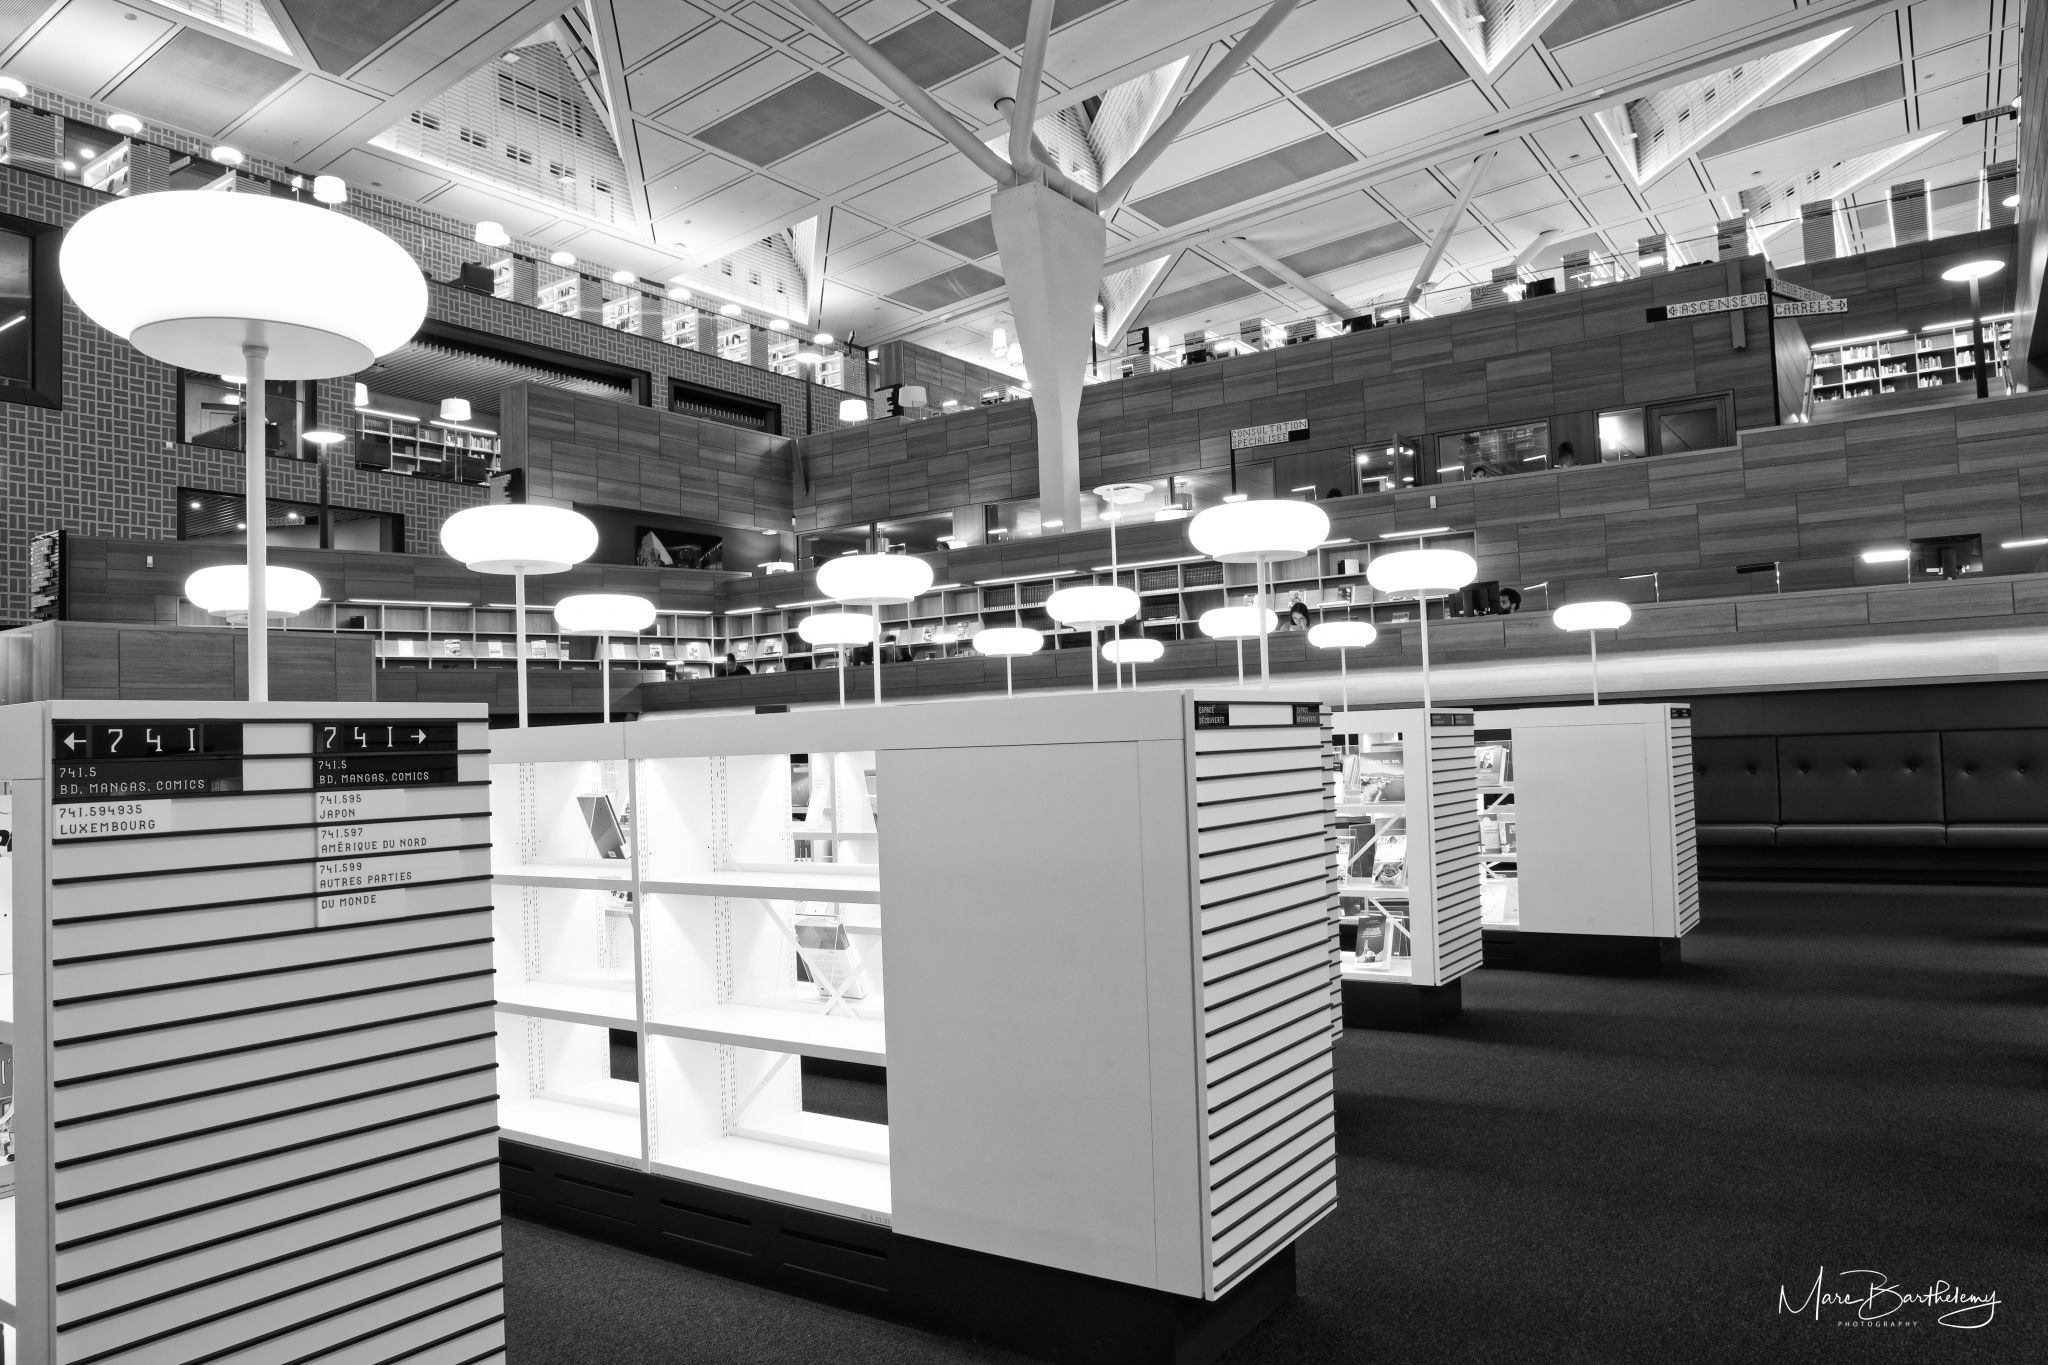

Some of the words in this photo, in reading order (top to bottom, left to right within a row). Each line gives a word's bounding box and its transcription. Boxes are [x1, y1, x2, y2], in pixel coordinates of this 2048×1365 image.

[1681, 293, 1767, 315] ASCENSEUR
[1775, 300, 1834, 315] CARRELS
[1231, 420, 1307, 438] CONSULTATION
[318, 759, 347, 770] 741.5
[59, 766, 97, 778] 741.5
[391, 771, 429, 782] COMICS
[156, 779, 205, 791] COMICS
[319, 793, 362, 804] 741.595
[59, 804, 143, 818] 741.594935
[319, 808, 355, 819] JAPON
[60, 819, 156, 835] LUXEMBOURG
[321, 827, 363, 839] 741.597
[321, 841, 377, 854] AMÉRIQUE
[383, 840, 395, 849] DU
[400, 837, 427, 848] NORD
[320, 862, 362, 874] 741.599
[320, 876, 362, 889] AUTRES
[367, 871, 412, 885] PARTIES
[321, 900, 335, 909] DU
[340, 894, 377, 907] MONDE
